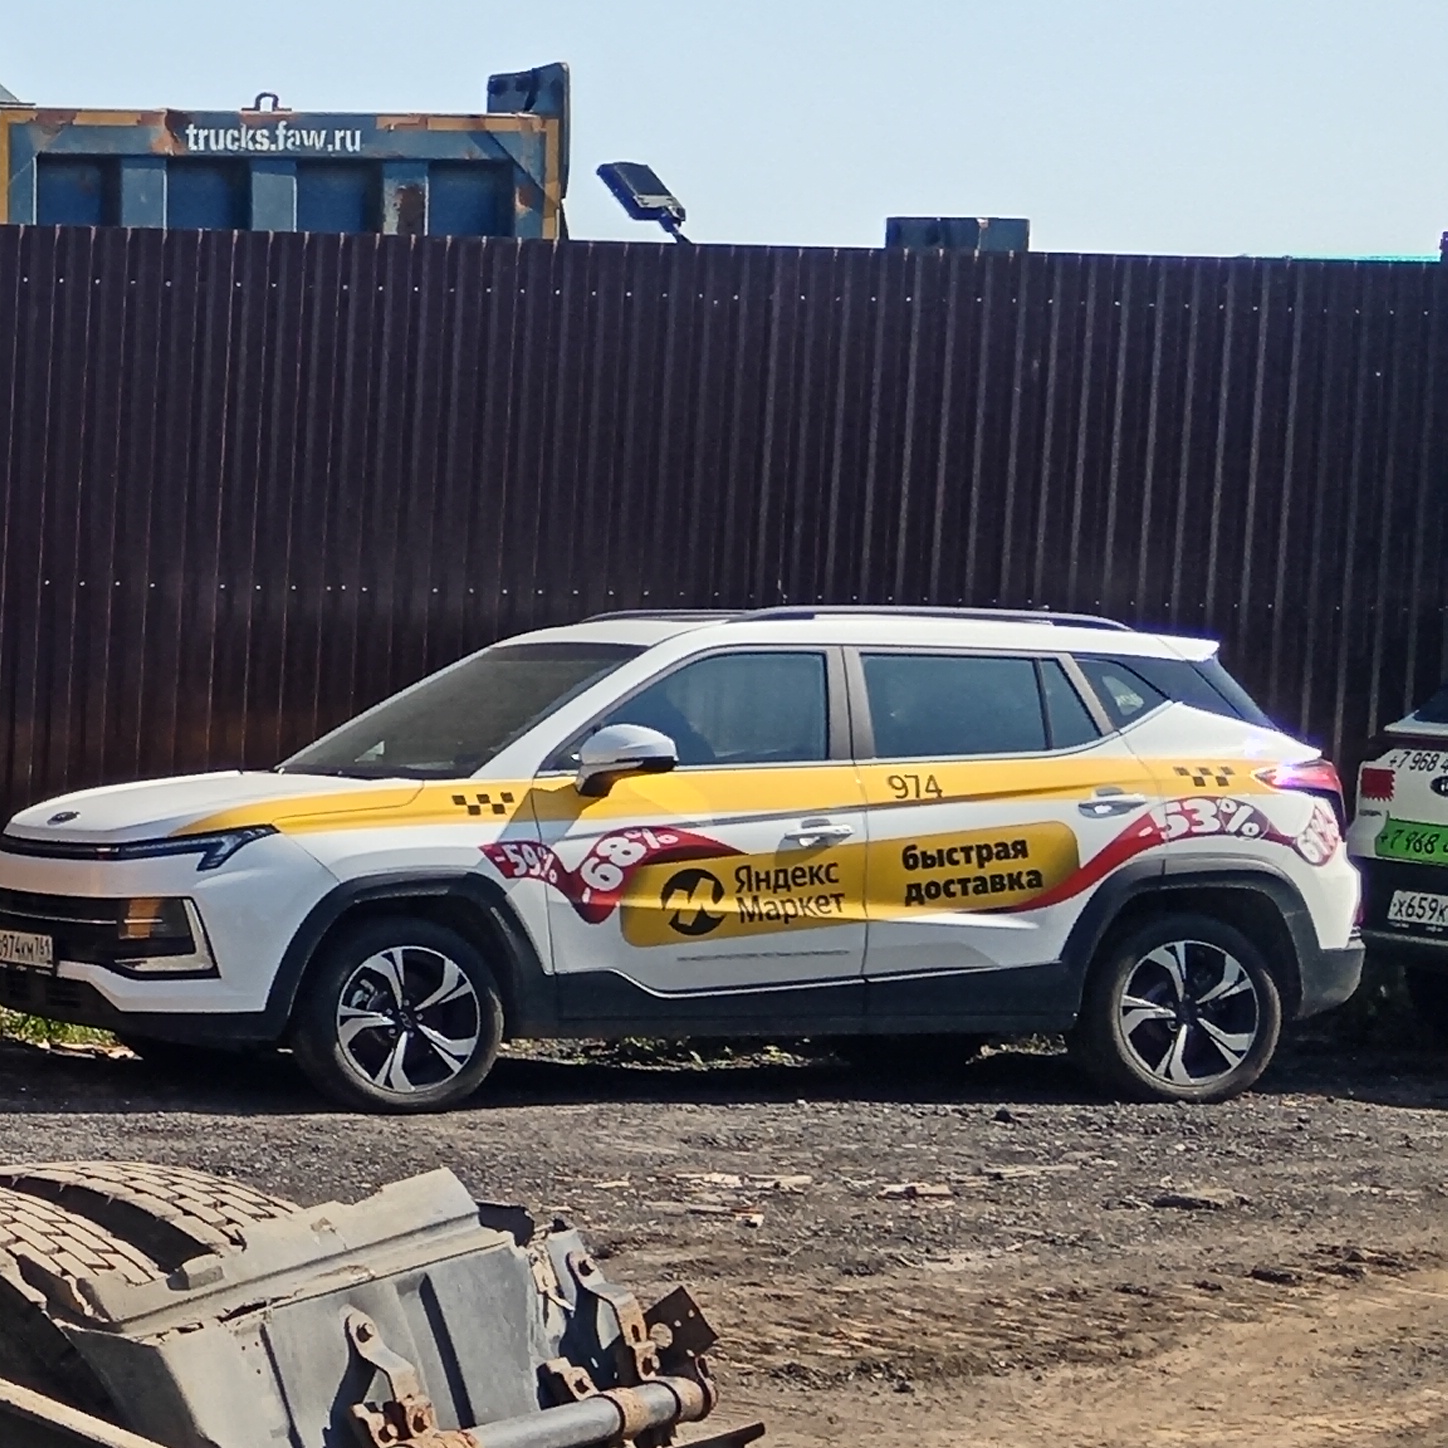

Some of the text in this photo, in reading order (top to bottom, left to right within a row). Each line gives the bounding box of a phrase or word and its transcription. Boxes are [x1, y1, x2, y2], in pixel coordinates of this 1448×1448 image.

[185, 120, 362, 152] trucks.faw.ru
[1409, 752, 1440, 771] 968
[887, 774, 943, 799] 974
[495, 843, 558, 884] -59%
[580, 828, 679, 904] -68%
[902, 839, 1029, 871] быстрая
[734, 862, 840, 895] Яндекс
[905, 869, 1044, 907] доставка
[736, 893, 845, 925] Маркет
